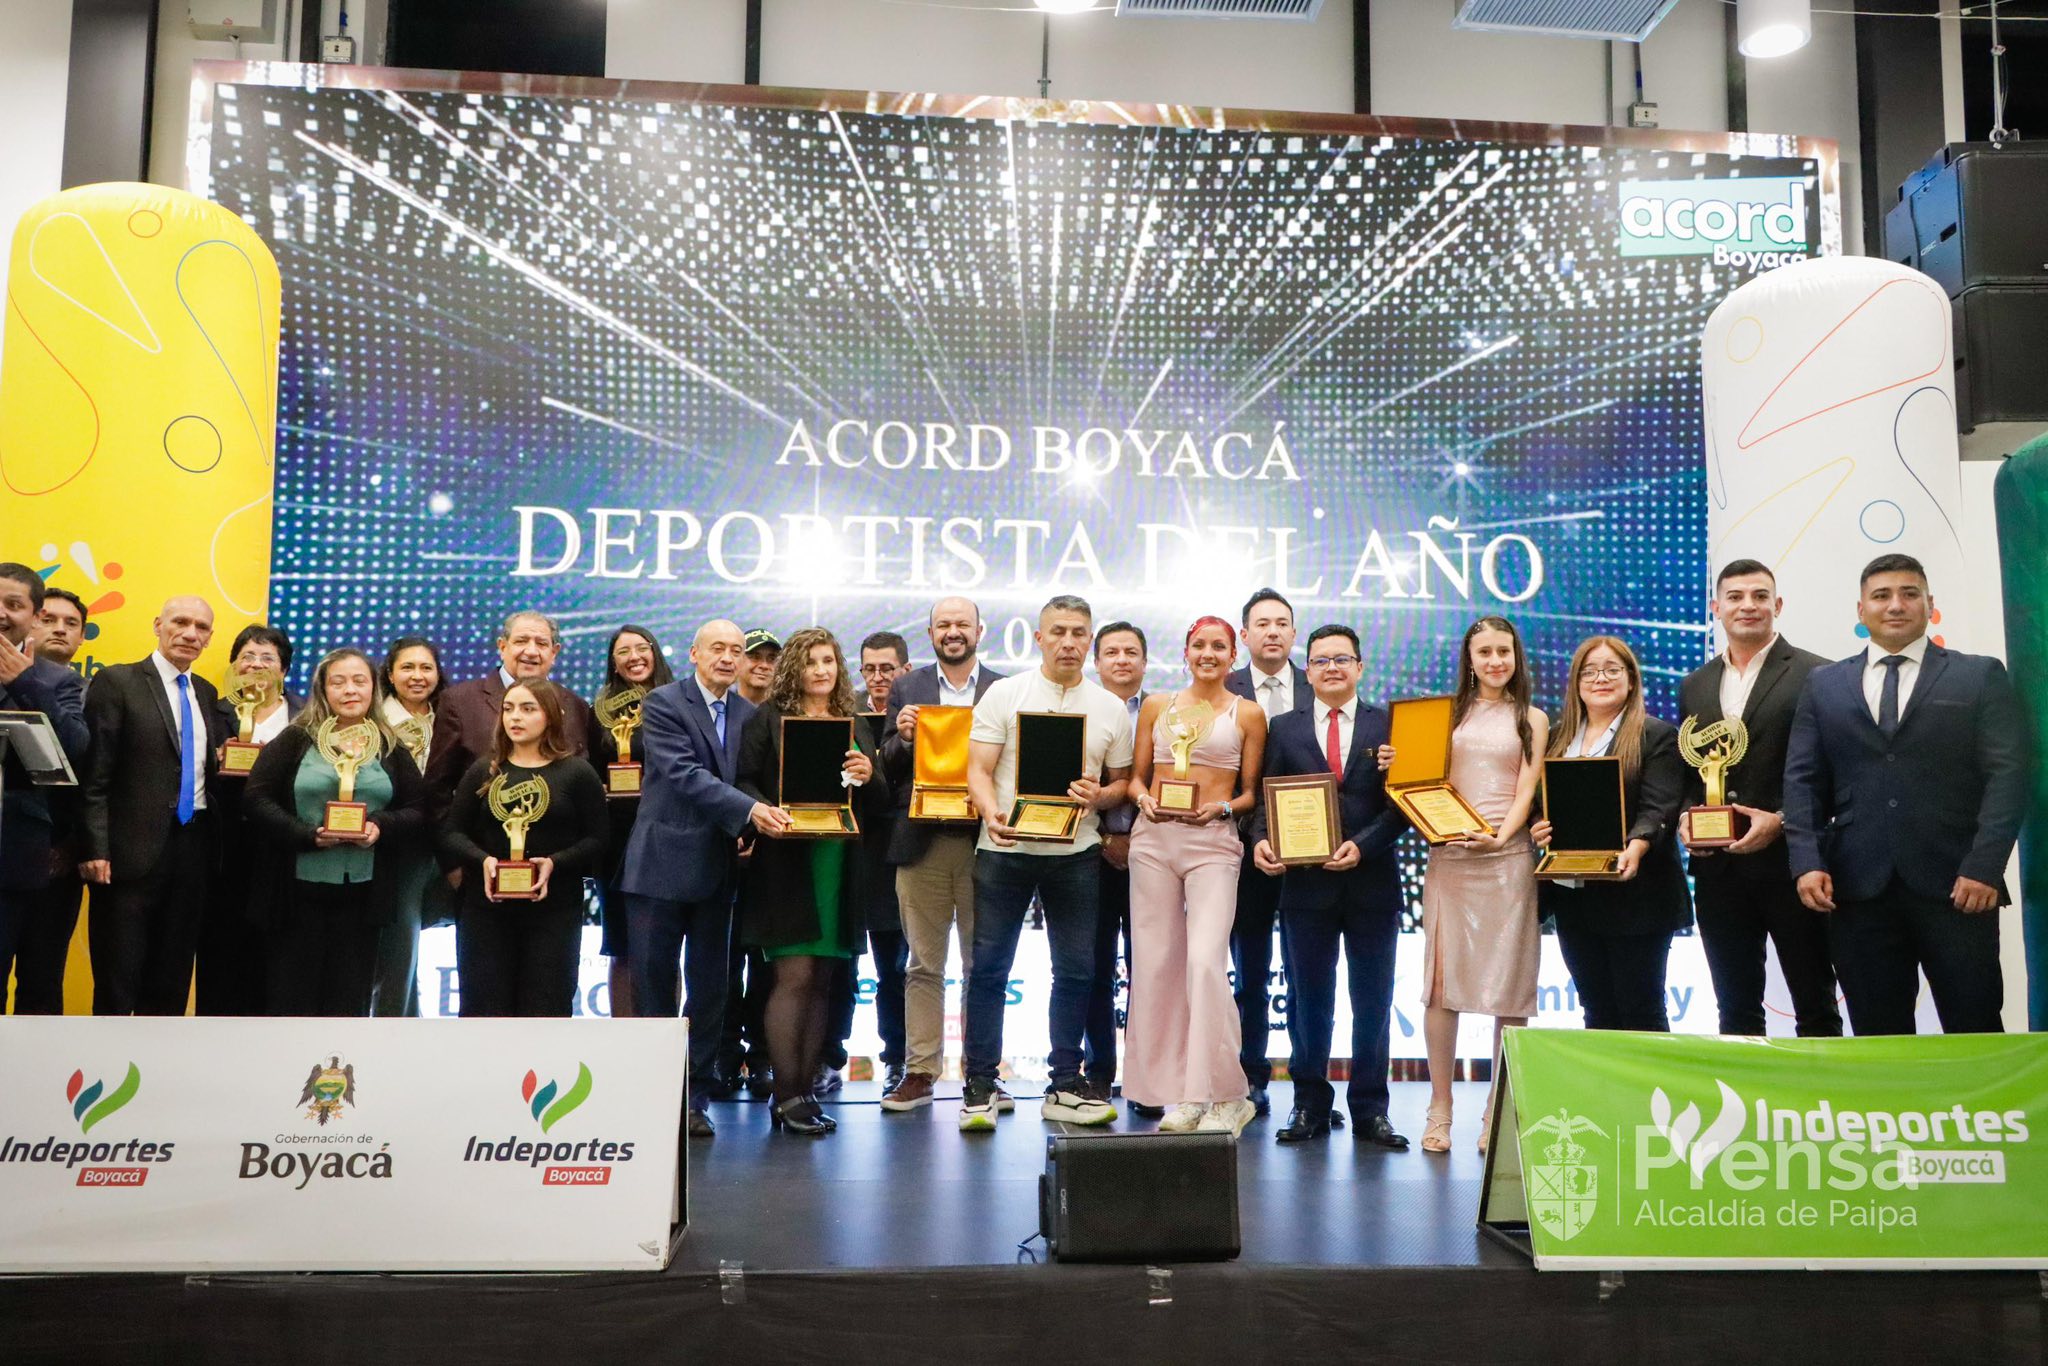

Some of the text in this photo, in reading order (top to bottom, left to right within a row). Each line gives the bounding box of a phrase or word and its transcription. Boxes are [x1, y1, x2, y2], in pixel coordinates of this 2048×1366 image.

[1620, 182, 1806, 243] acord
[775, 418, 1301, 481] ACORD BOYACÁ
[509, 505, 1544, 602] DEPORTISTA DEL AÑO
[274, 1133, 373, 1145] Gobernación de
[1756, 1098, 2030, 1153] Indeportes
[0, 1136, 175, 1169] Indeportes
[239, 1141, 393, 1190] Boyacá
[463, 1135, 635, 1168] Indeportes
[1906, 1153, 1996, 1181] Boyacá
[83, 1169, 141, 1186] Boyacá
[549, 1168, 605, 1185] Boyacá
